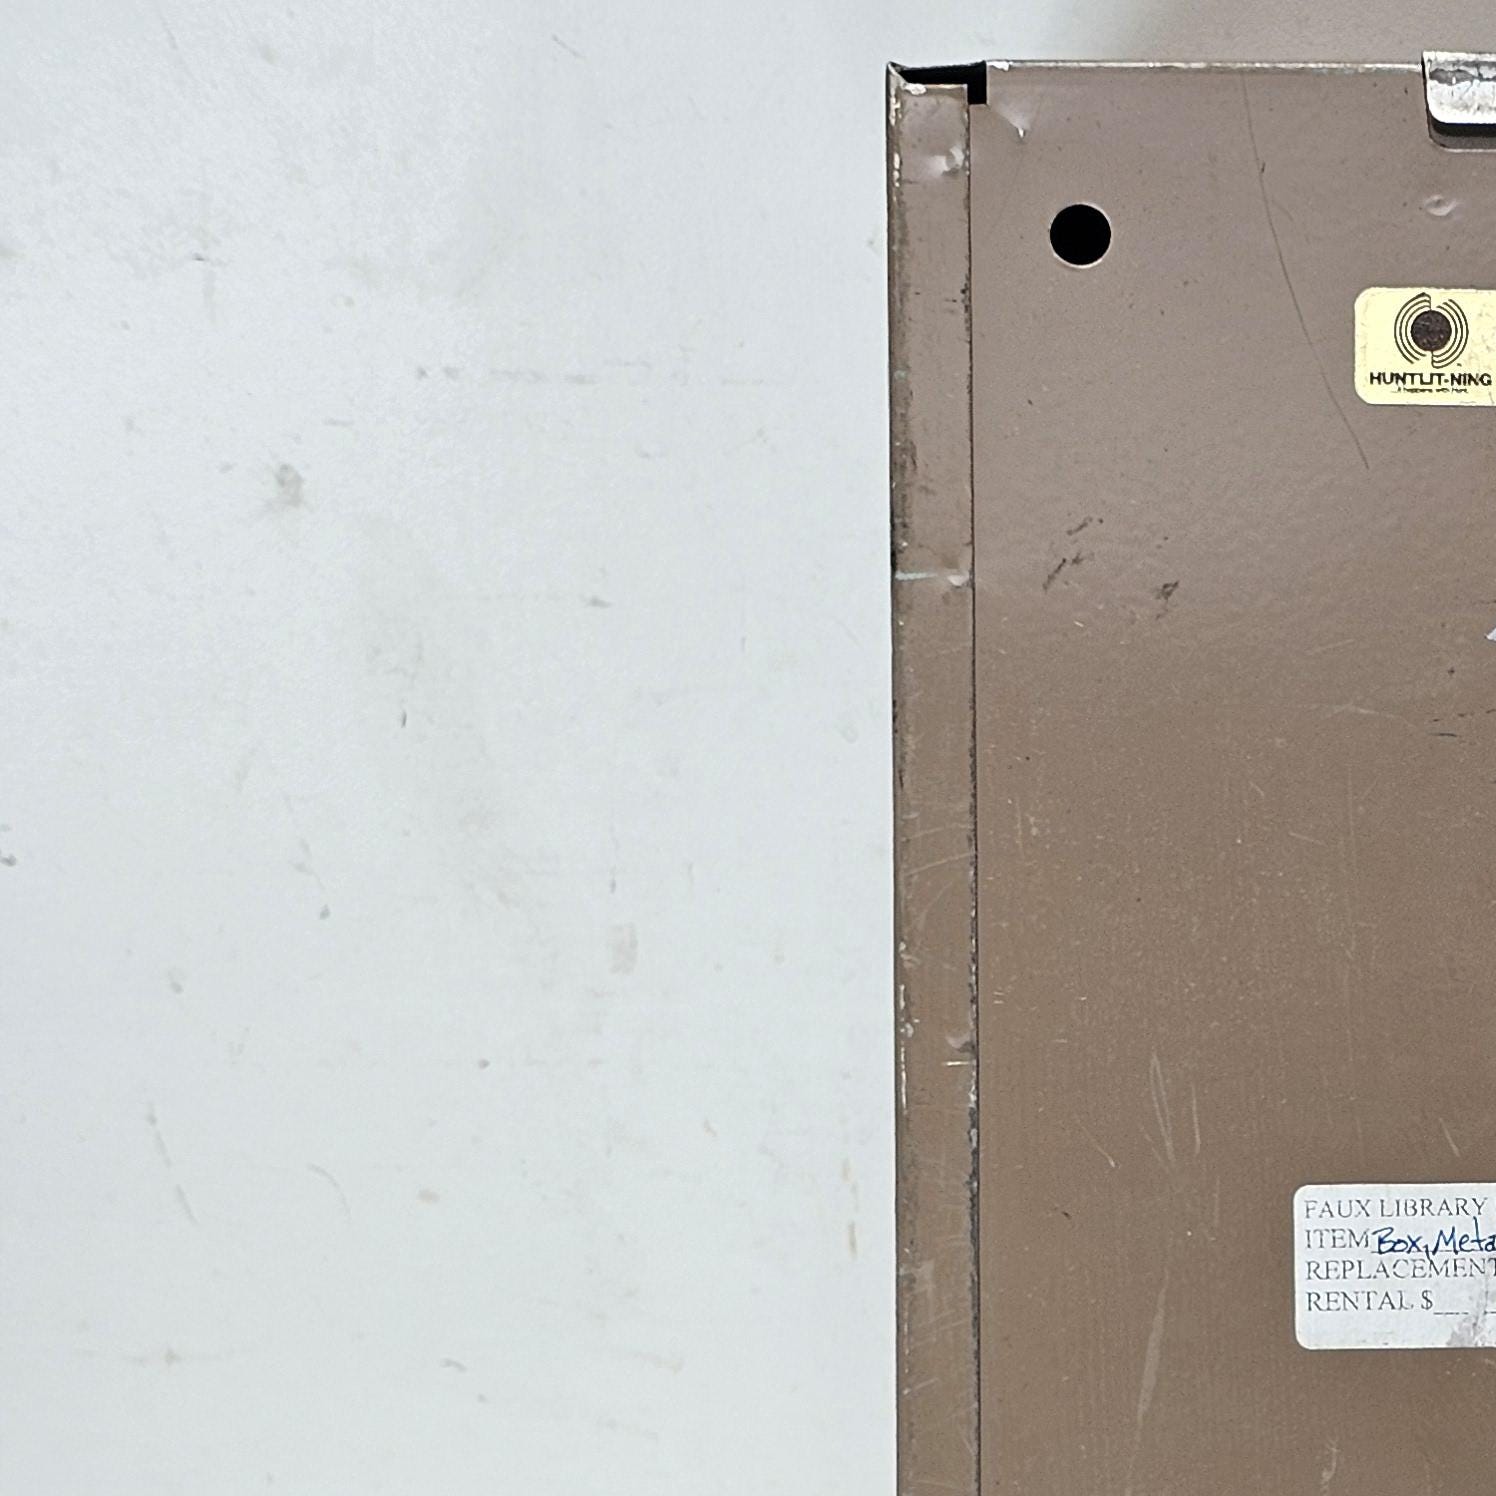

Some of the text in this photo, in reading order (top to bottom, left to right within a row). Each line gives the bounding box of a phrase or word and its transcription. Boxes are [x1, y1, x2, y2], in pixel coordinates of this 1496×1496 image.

[1304, 1198, 1371, 1219] FAUX
[1379, 1196, 1488, 1218] LIBRARY
[1306, 1229, 1369, 1249] ITEM
[1306, 1290, 1416, 1312] RENTAL
[1421, 1289, 1434, 1312] $
